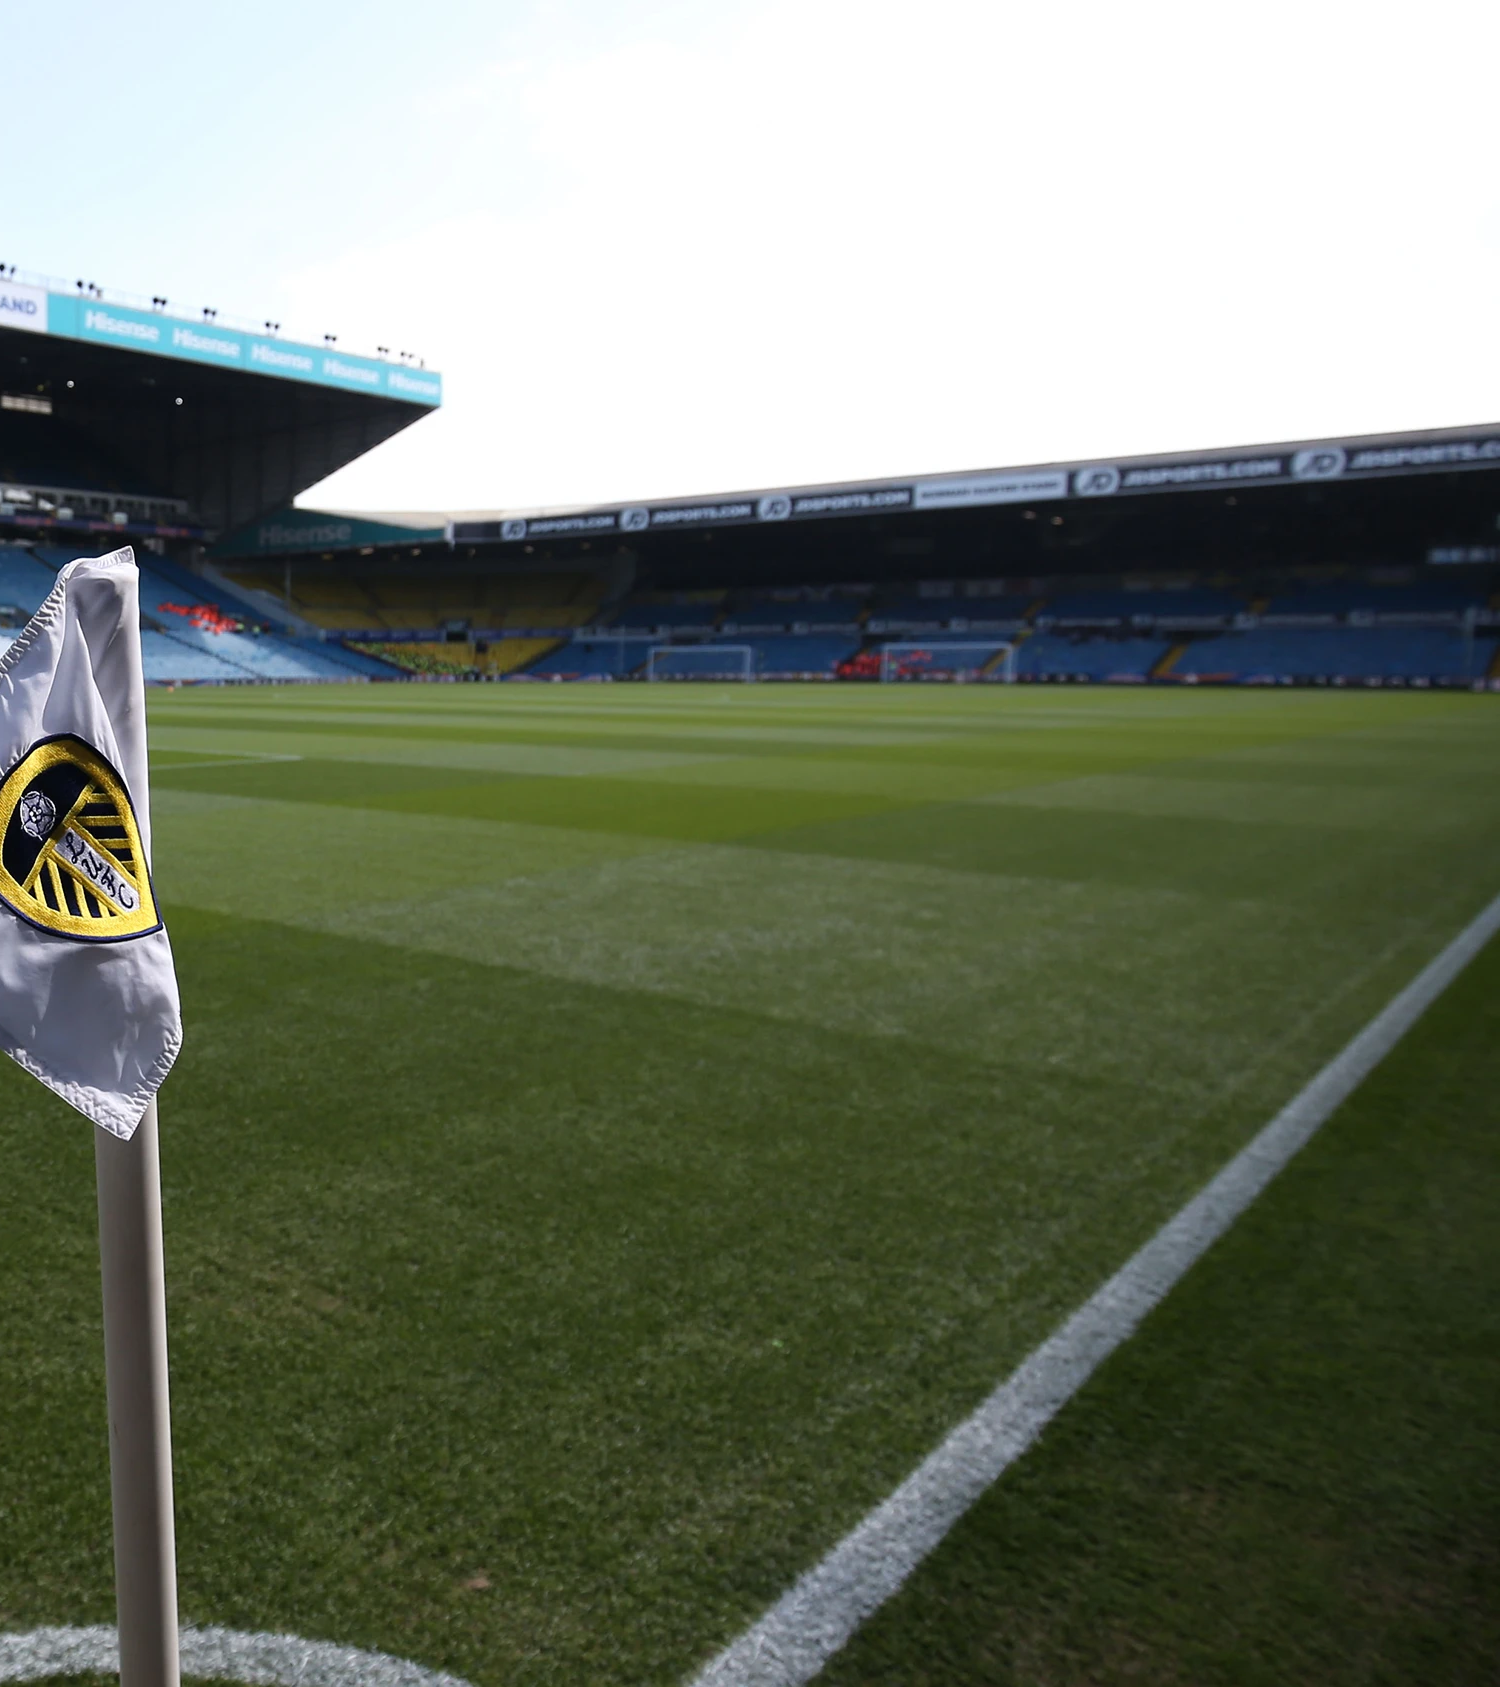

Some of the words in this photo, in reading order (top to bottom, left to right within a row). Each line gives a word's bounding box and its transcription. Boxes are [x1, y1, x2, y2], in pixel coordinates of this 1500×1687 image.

[85, 309, 160, 342] Hisense
[173, 327, 240, 358] Hisense
[252, 343, 313, 372] Hisense
[323, 357, 381, 385] Hisense
[389, 370, 439, 395] Hisense
[258, 523, 352, 546] Hisense
